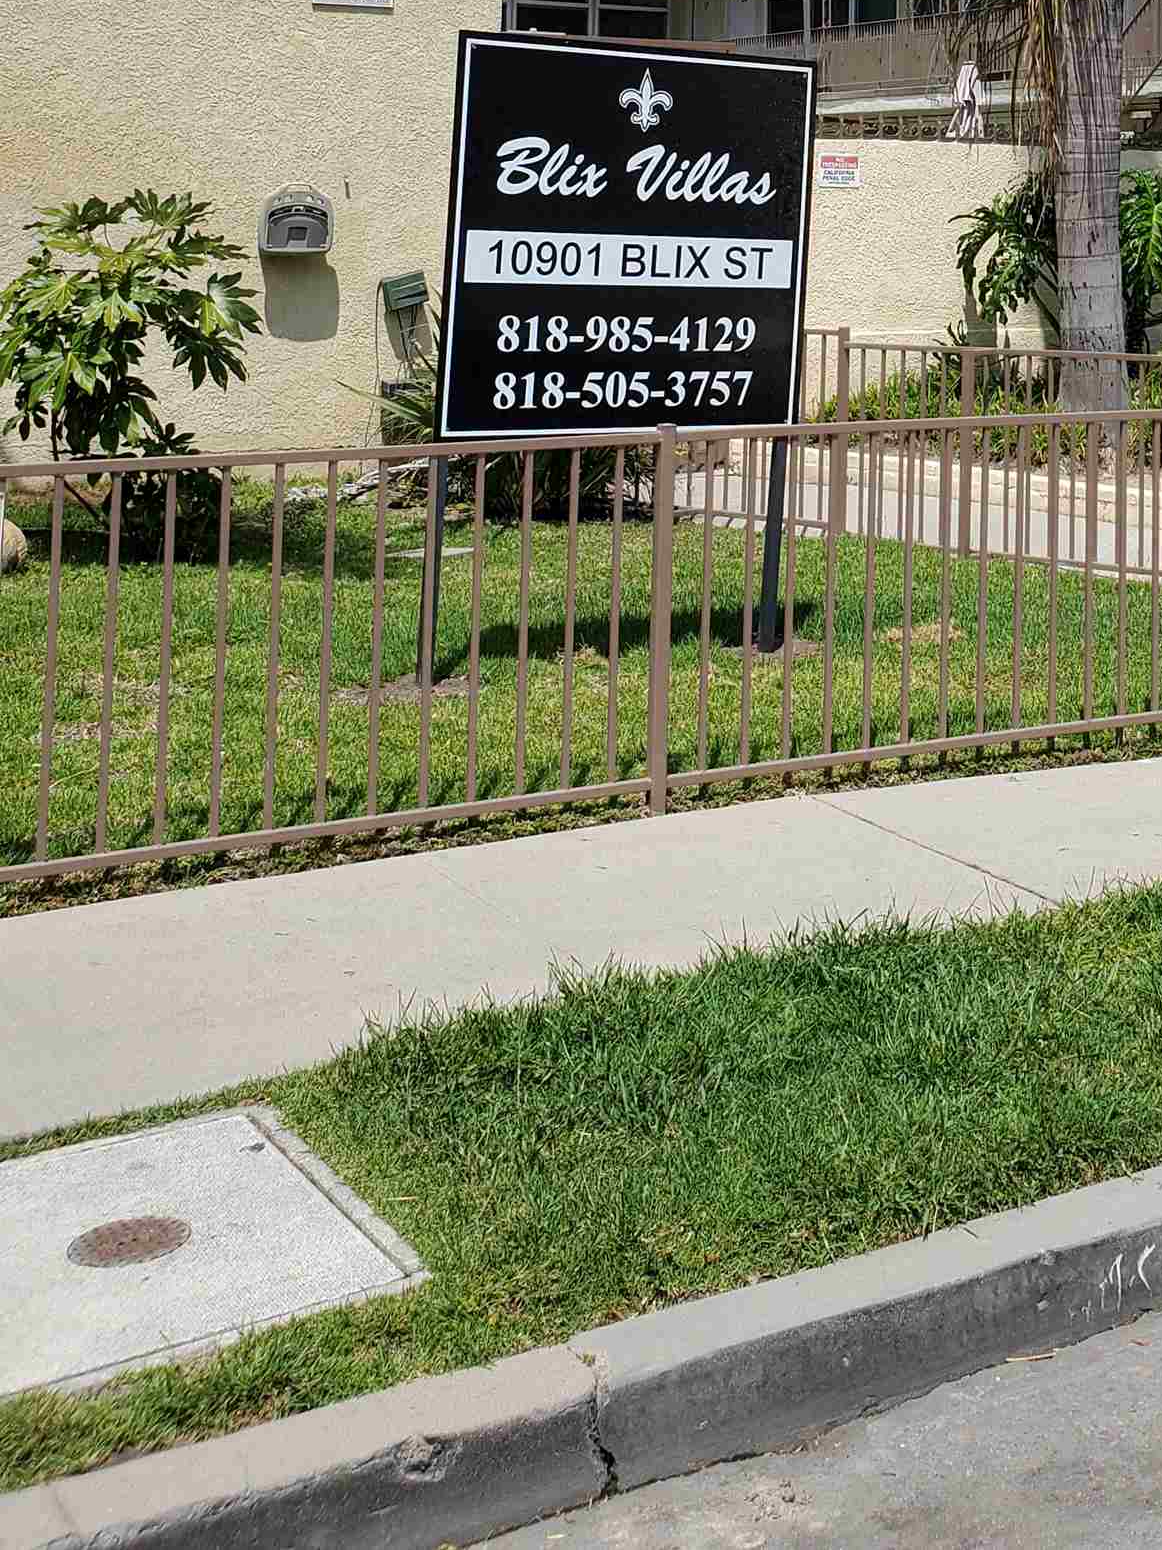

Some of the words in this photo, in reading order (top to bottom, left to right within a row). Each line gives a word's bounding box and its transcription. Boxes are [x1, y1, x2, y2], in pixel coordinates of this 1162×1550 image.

[496, 136, 608, 198] Blix
[625, 144, 777, 205] Villas
[488, 239, 601, 277] 10901
[620, 243, 711, 279] BLIX
[723, 246, 774, 280] ST
[496, 314, 757, 353] 818-985-4129
[492, 370, 754, 410] 818-505-3757
